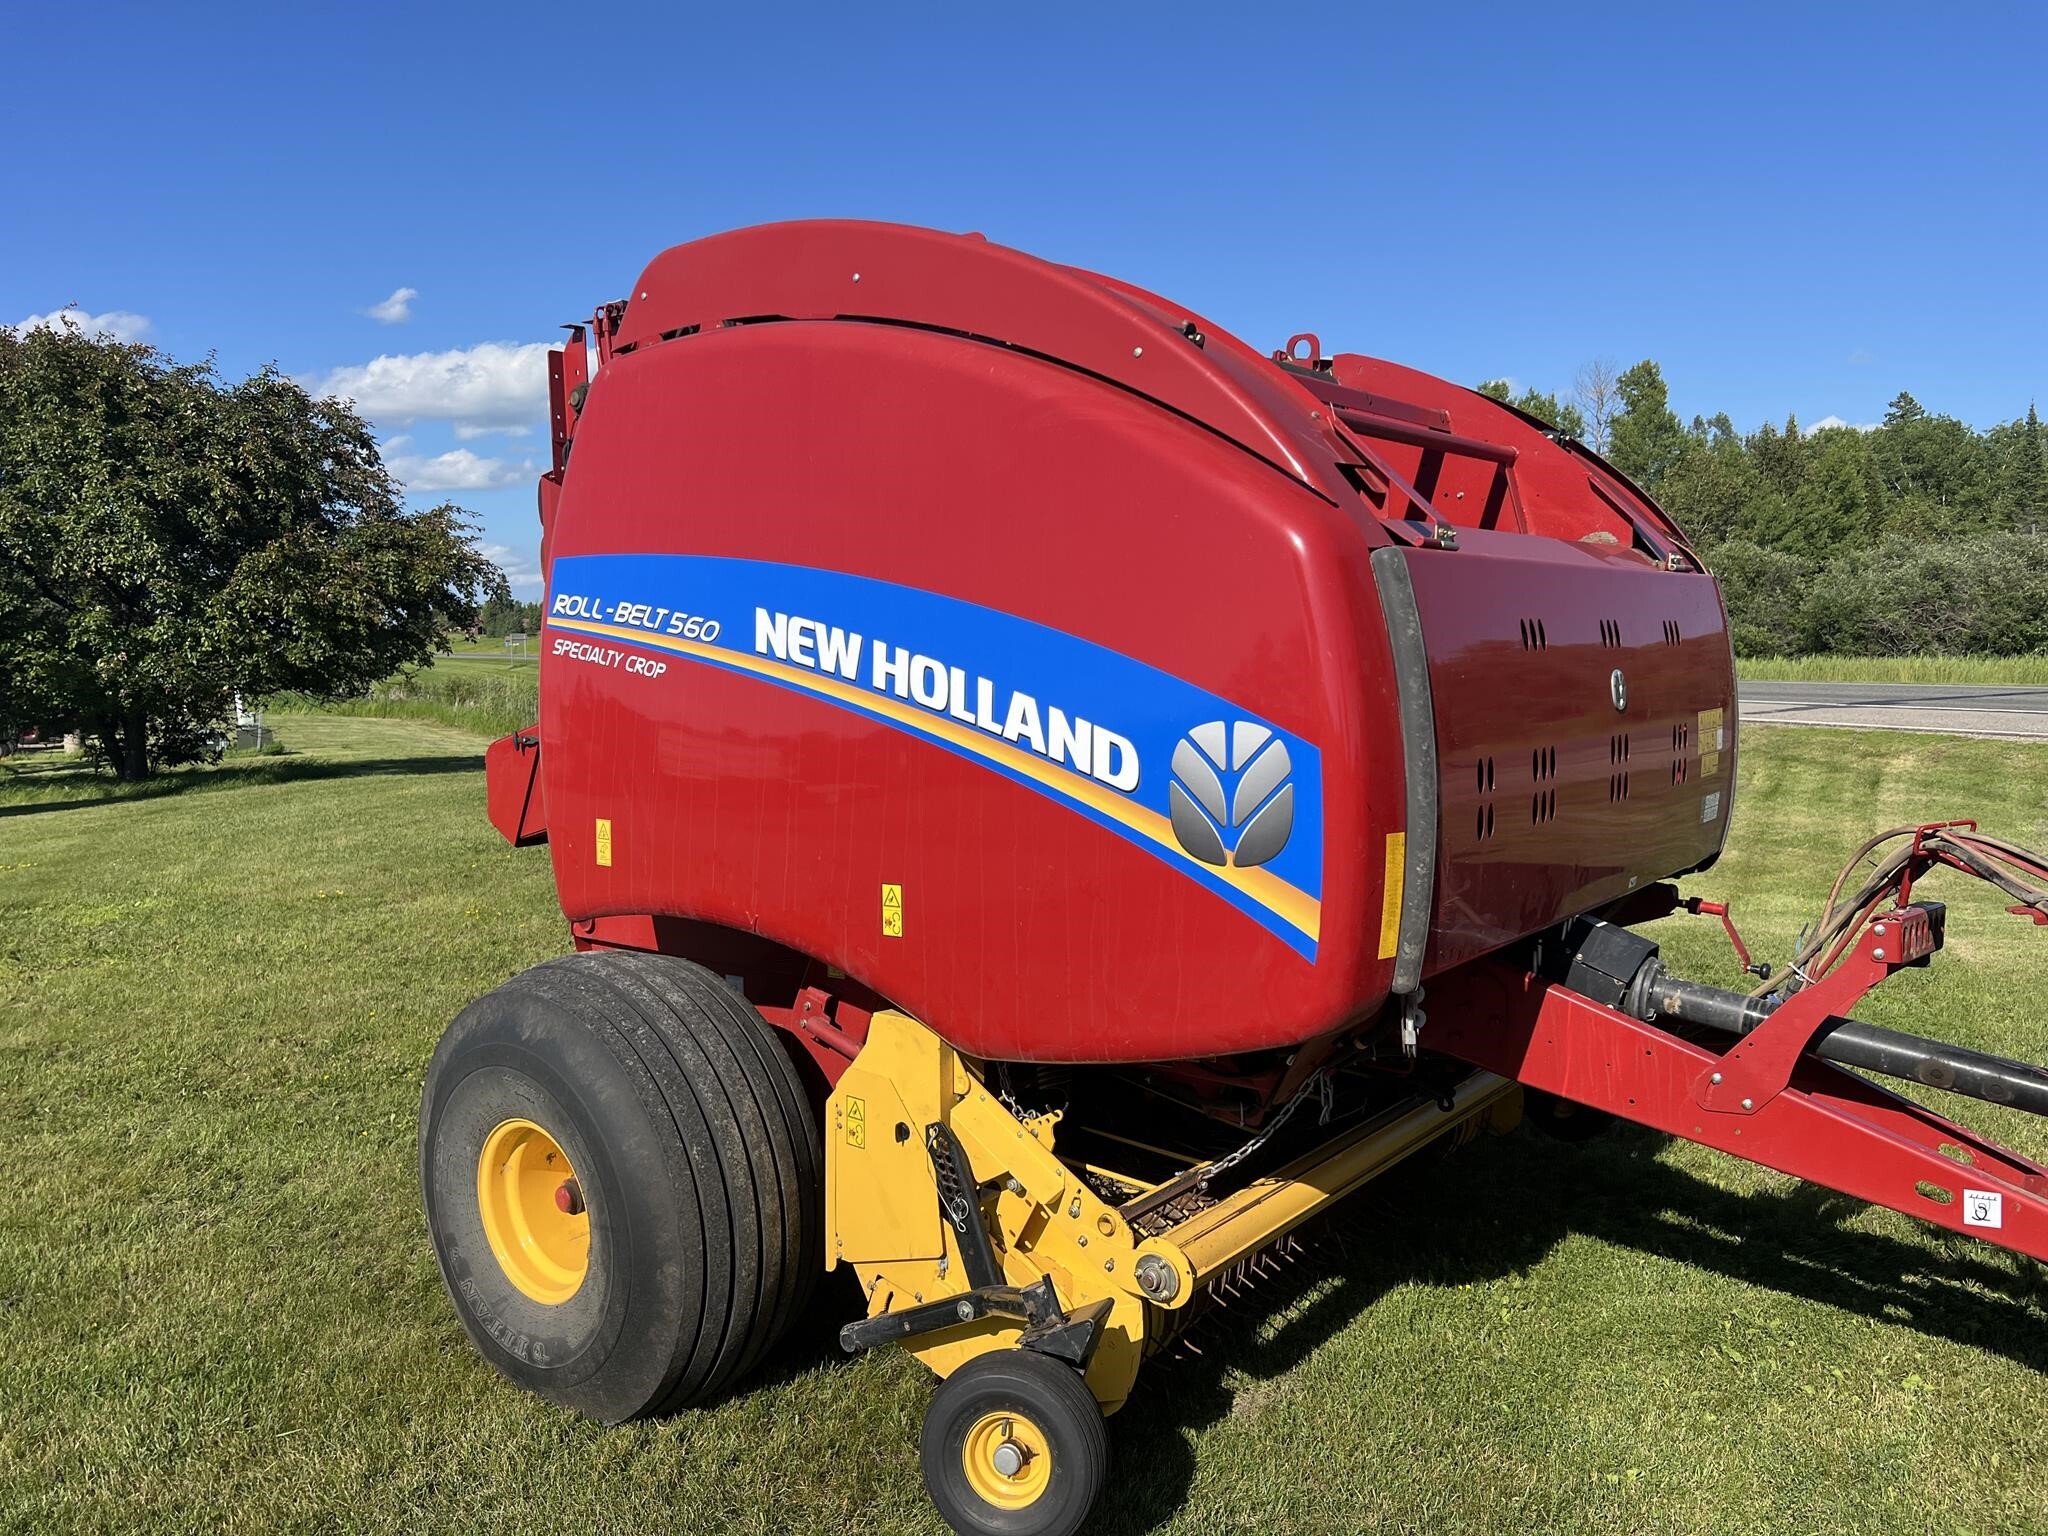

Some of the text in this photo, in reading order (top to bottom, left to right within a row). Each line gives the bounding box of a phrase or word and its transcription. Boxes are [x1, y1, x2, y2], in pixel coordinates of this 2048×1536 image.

[666, 611, 721, 643] 560
[552, 638, 667, 679] SPECIALTY CROP
[755, 606, 1141, 794] NEW HOLLAND
[461, 1279, 528, 1361] TITAN
